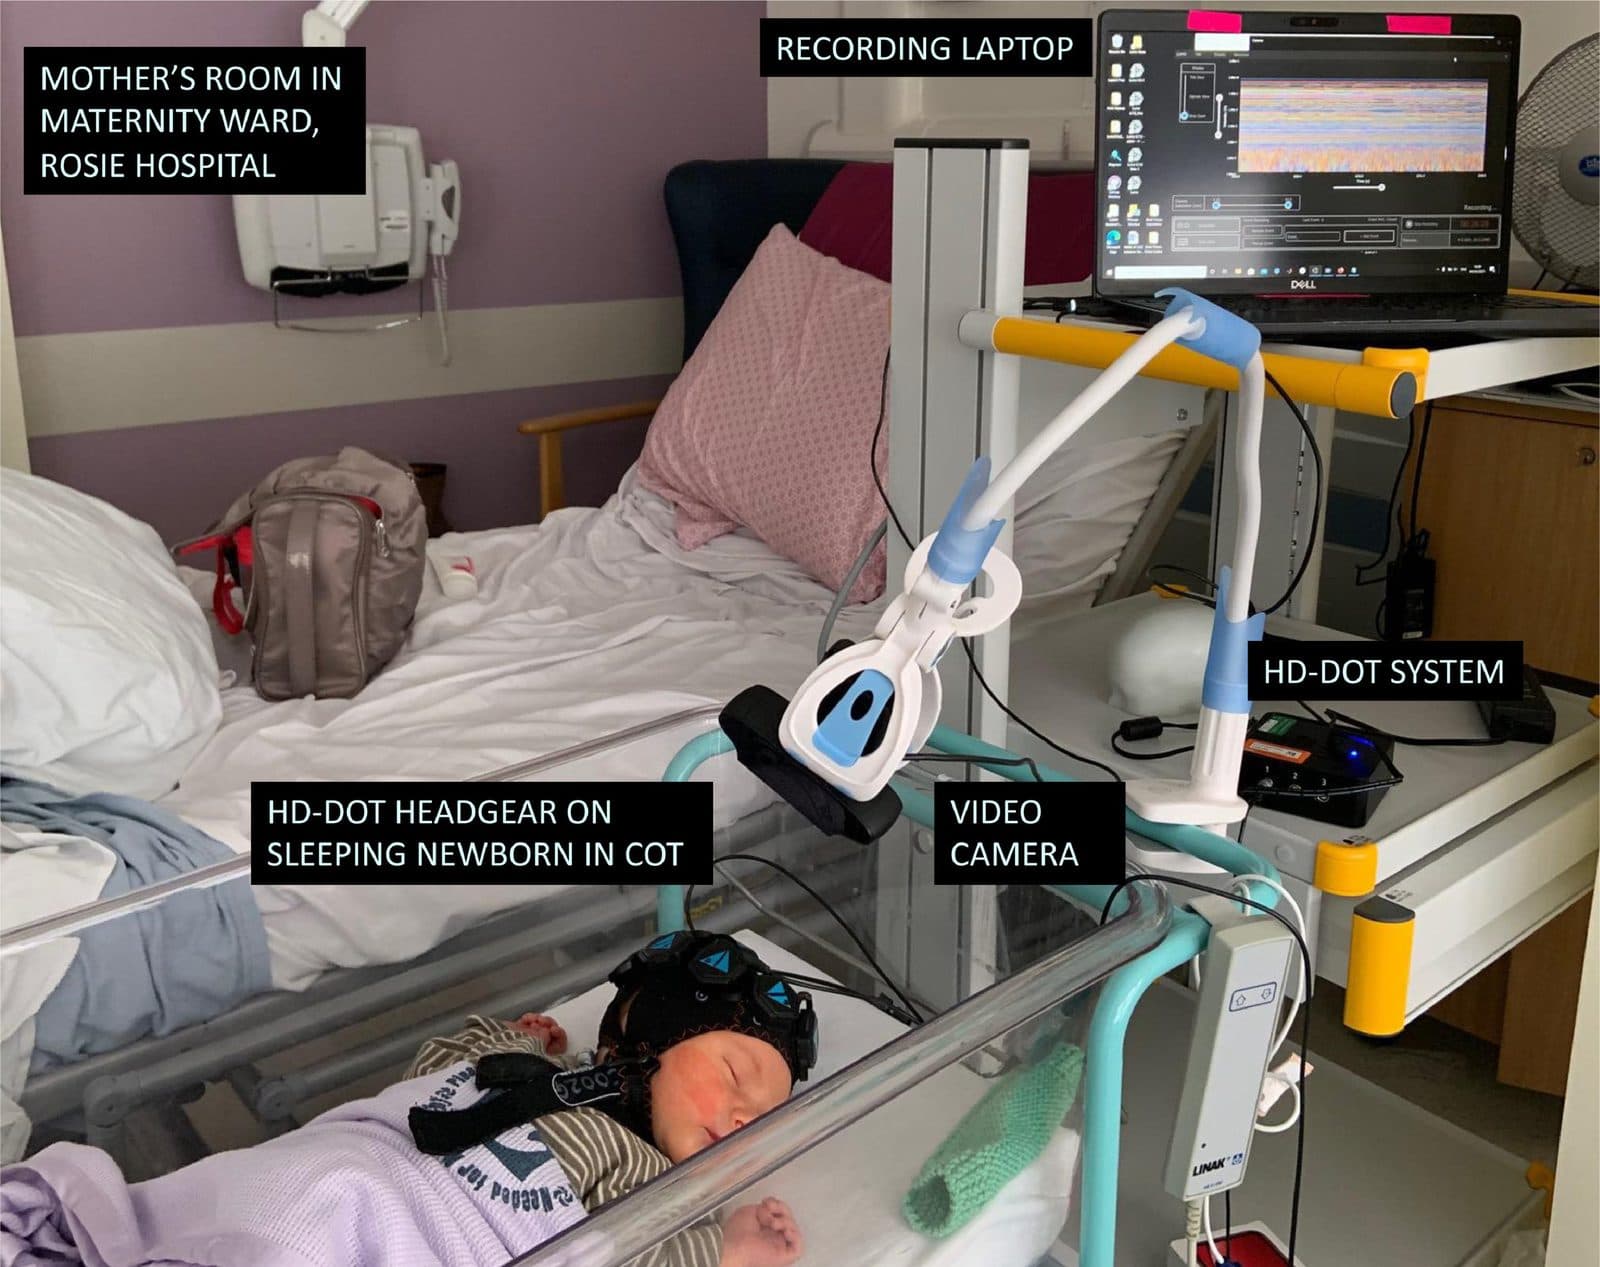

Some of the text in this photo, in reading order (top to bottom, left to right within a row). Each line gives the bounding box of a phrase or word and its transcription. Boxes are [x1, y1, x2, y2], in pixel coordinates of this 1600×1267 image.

[1290, 280, 1317, 289] DELL
[1265, 765, 1270, 773] 1
[1192, 1157, 1226, 1177] LINAK
[457, 1163, 554, 1213] Needed for
